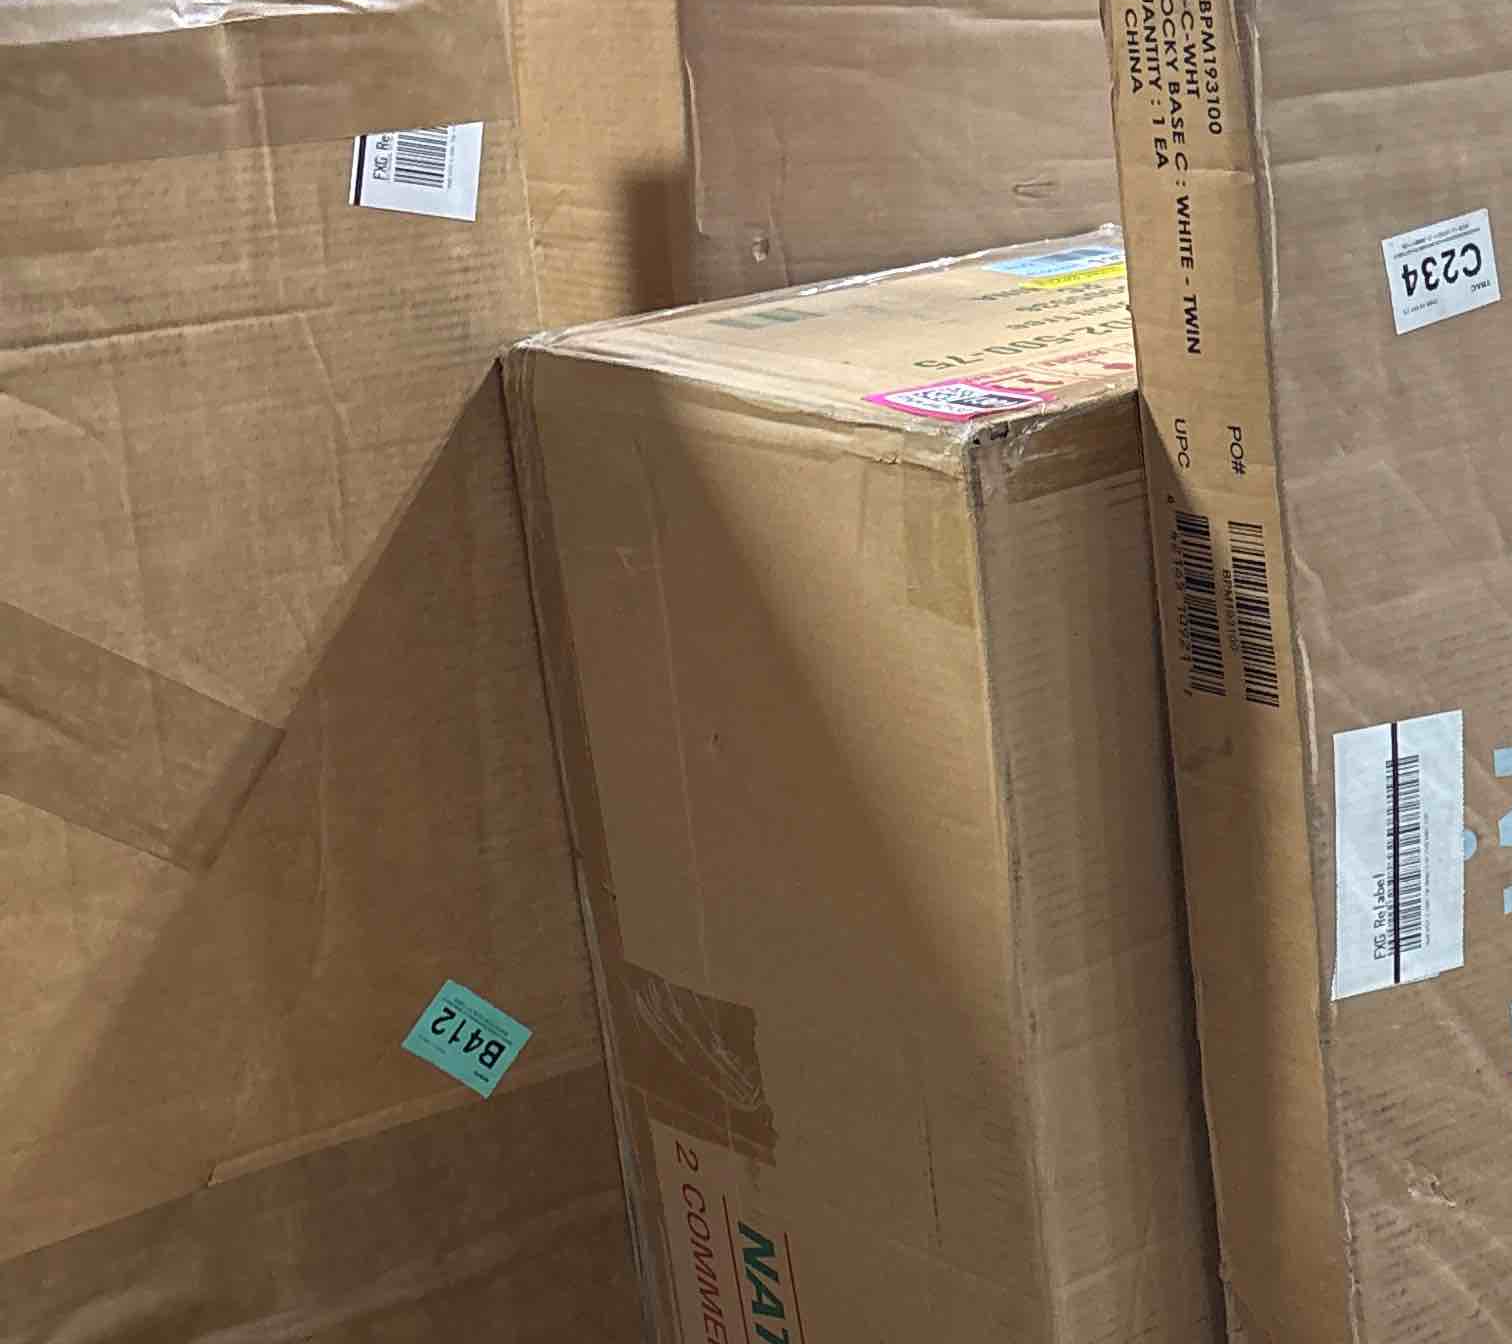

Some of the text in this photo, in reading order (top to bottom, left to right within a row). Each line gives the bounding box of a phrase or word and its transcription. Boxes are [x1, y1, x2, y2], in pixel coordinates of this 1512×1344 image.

[1125, 9, 1144, 94] CHINA
[1199, 0, 1223, 135] BPM193100
[1152, 116, 1166, 125] 1
[1168, 81, 1187, 145] BASE
[372, 155, 388, 180] FXG
[1154, 137, 1169, 169] EA
[1175, 152, 1188, 172] C
[1176, 195, 1195, 271] WHITE
[1401, 242, 1482, 296] C234
[1183, 294, 1201, 355] TWIN
[1174, 418, 1190, 469] UPC
[1227, 425, 1246, 476] PO#
[1372, 873, 1387, 961] FXG Relabel
[430, 1004, 503, 1069] B412
[674, 1140, 699, 1171] 2
